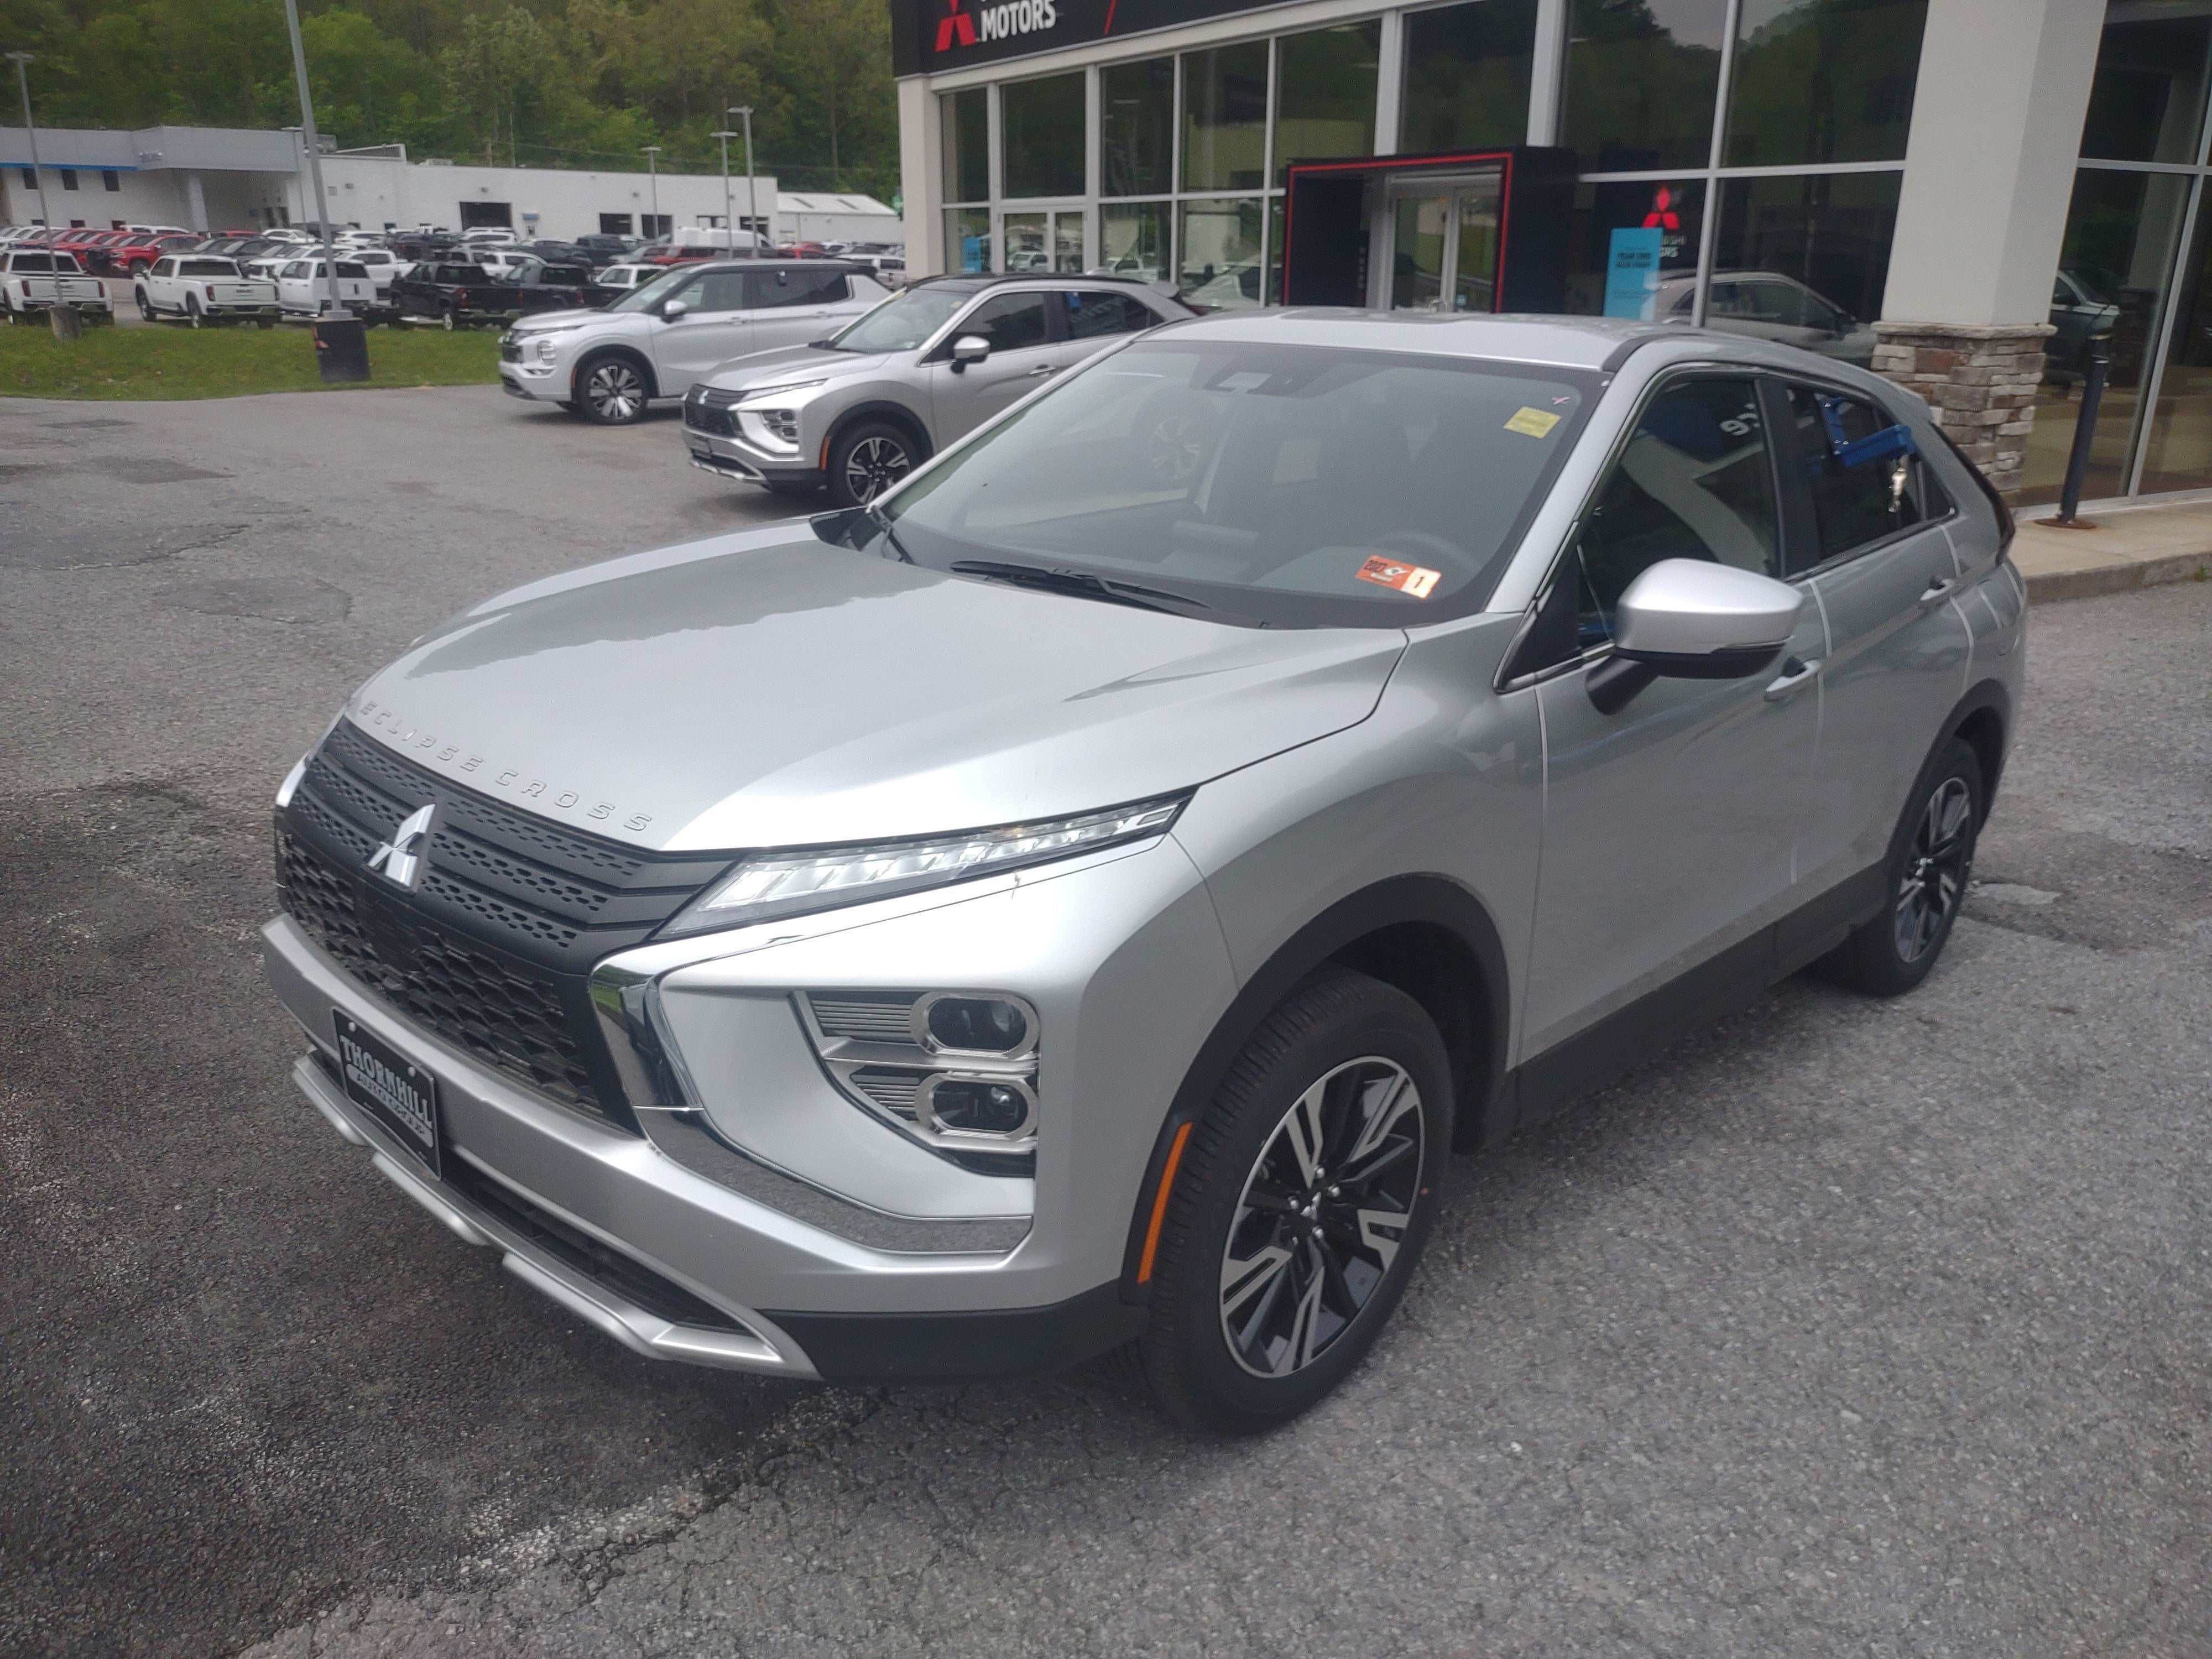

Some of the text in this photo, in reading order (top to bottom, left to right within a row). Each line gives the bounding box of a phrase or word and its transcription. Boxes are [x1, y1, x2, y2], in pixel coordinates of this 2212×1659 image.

[980, 0, 1056, 42] MOTORS
[1414, 576, 1425, 589] 1
[360, 701, 653, 831] ECLIPSE CROSS
